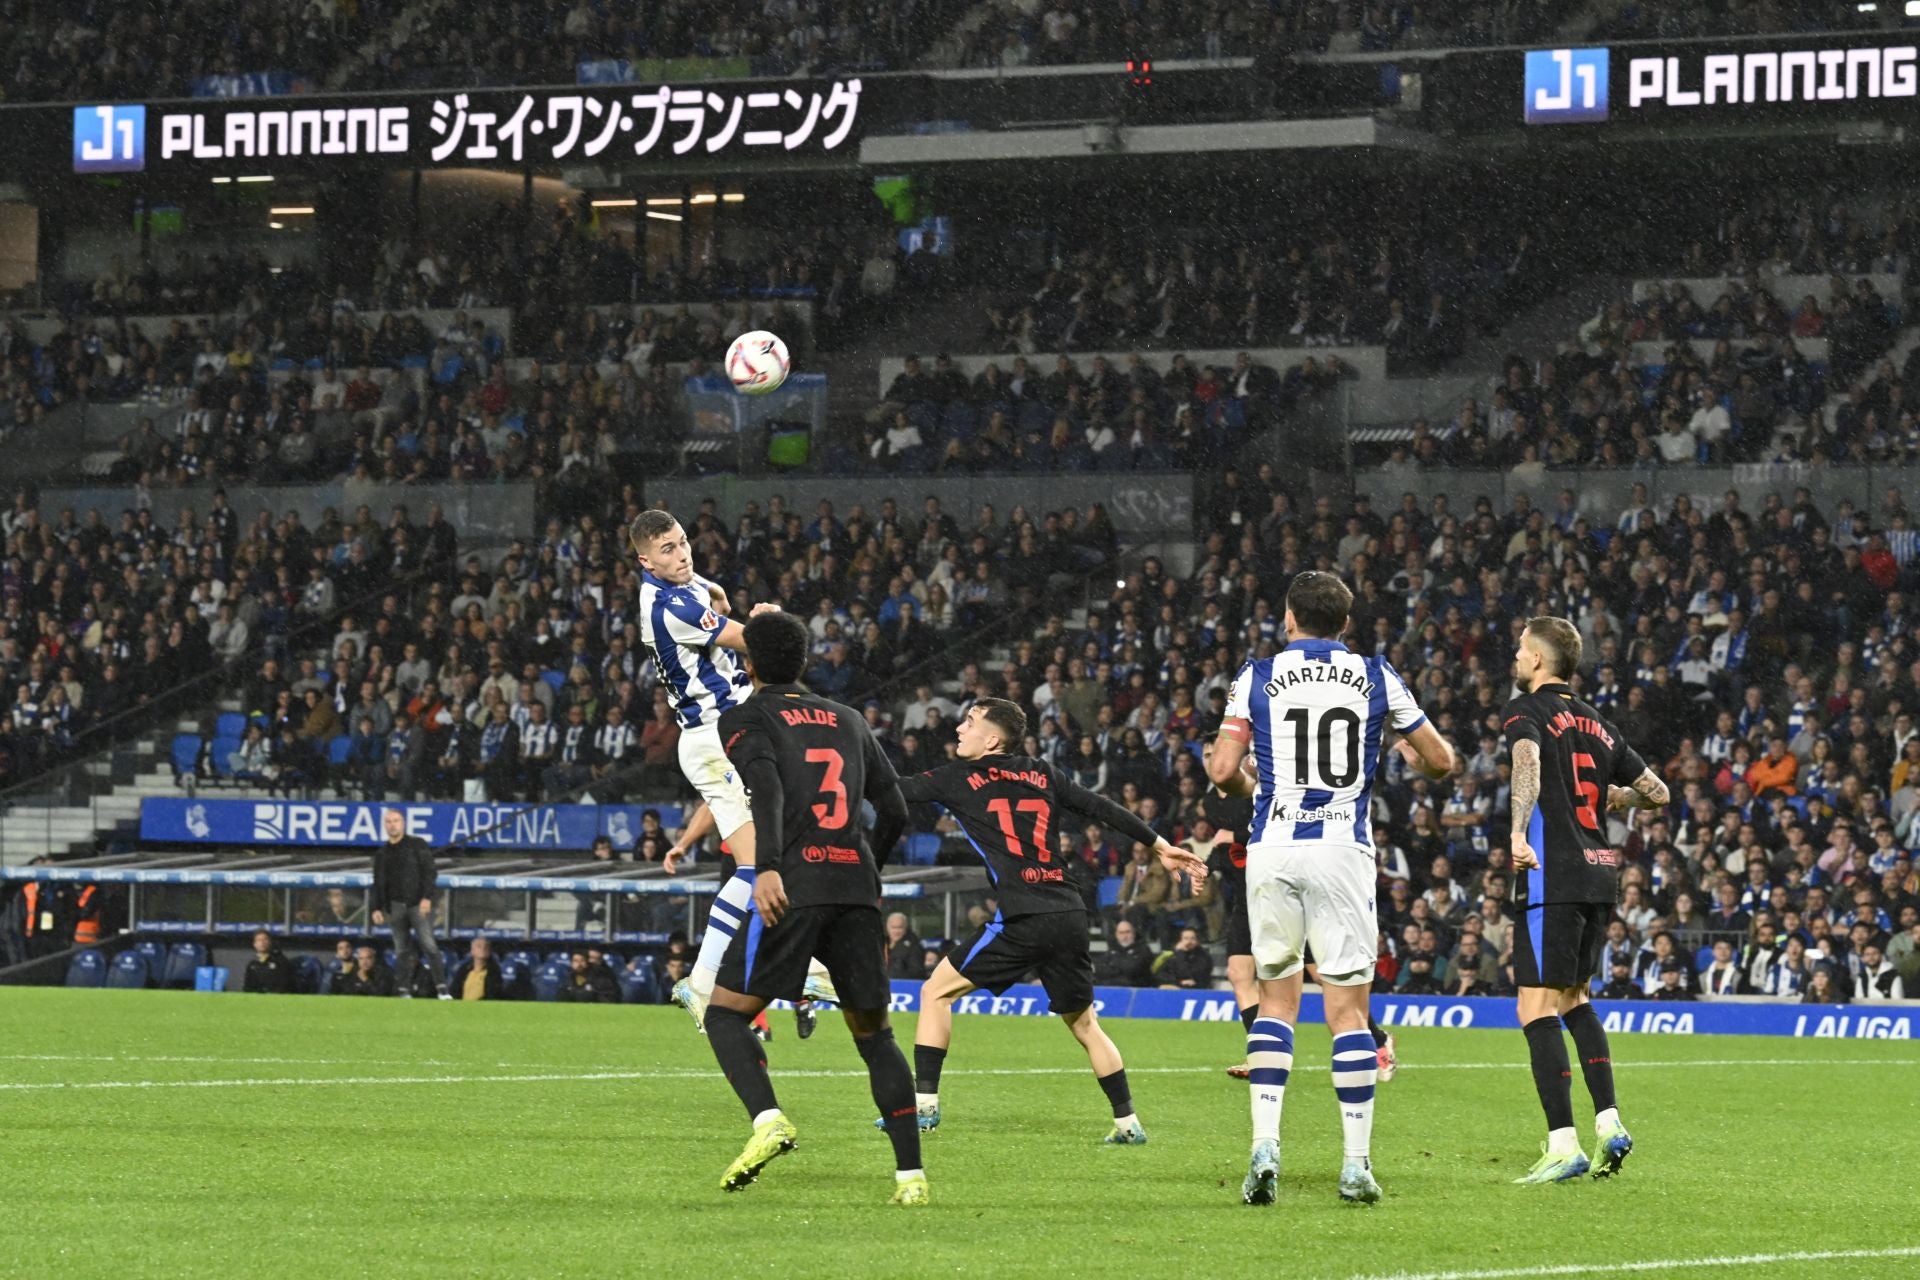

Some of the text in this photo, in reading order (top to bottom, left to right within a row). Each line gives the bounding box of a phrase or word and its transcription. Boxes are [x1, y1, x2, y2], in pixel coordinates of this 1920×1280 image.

[1535, 47, 1917, 109] J1 PLANNING
[82, 105, 409, 160] J1 PLANNING
[430, 78, 861, 161] ジェイ・ワン・プランニング
[1264, 665, 1375, 699] OYARZABAL
[780, 708, 838, 727] BALDE
[1283, 707, 1360, 788] 10
[805, 748, 849, 829] 3
[1572, 752, 1600, 830] 5
[449, 807, 561, 843] ARENA
[986, 798, 1051, 863] 17
[957, 996, 1105, 1016] KEL
[1181, 999, 1243, 1021] IM
[1602, 1011, 1695, 1034] ALIGA
